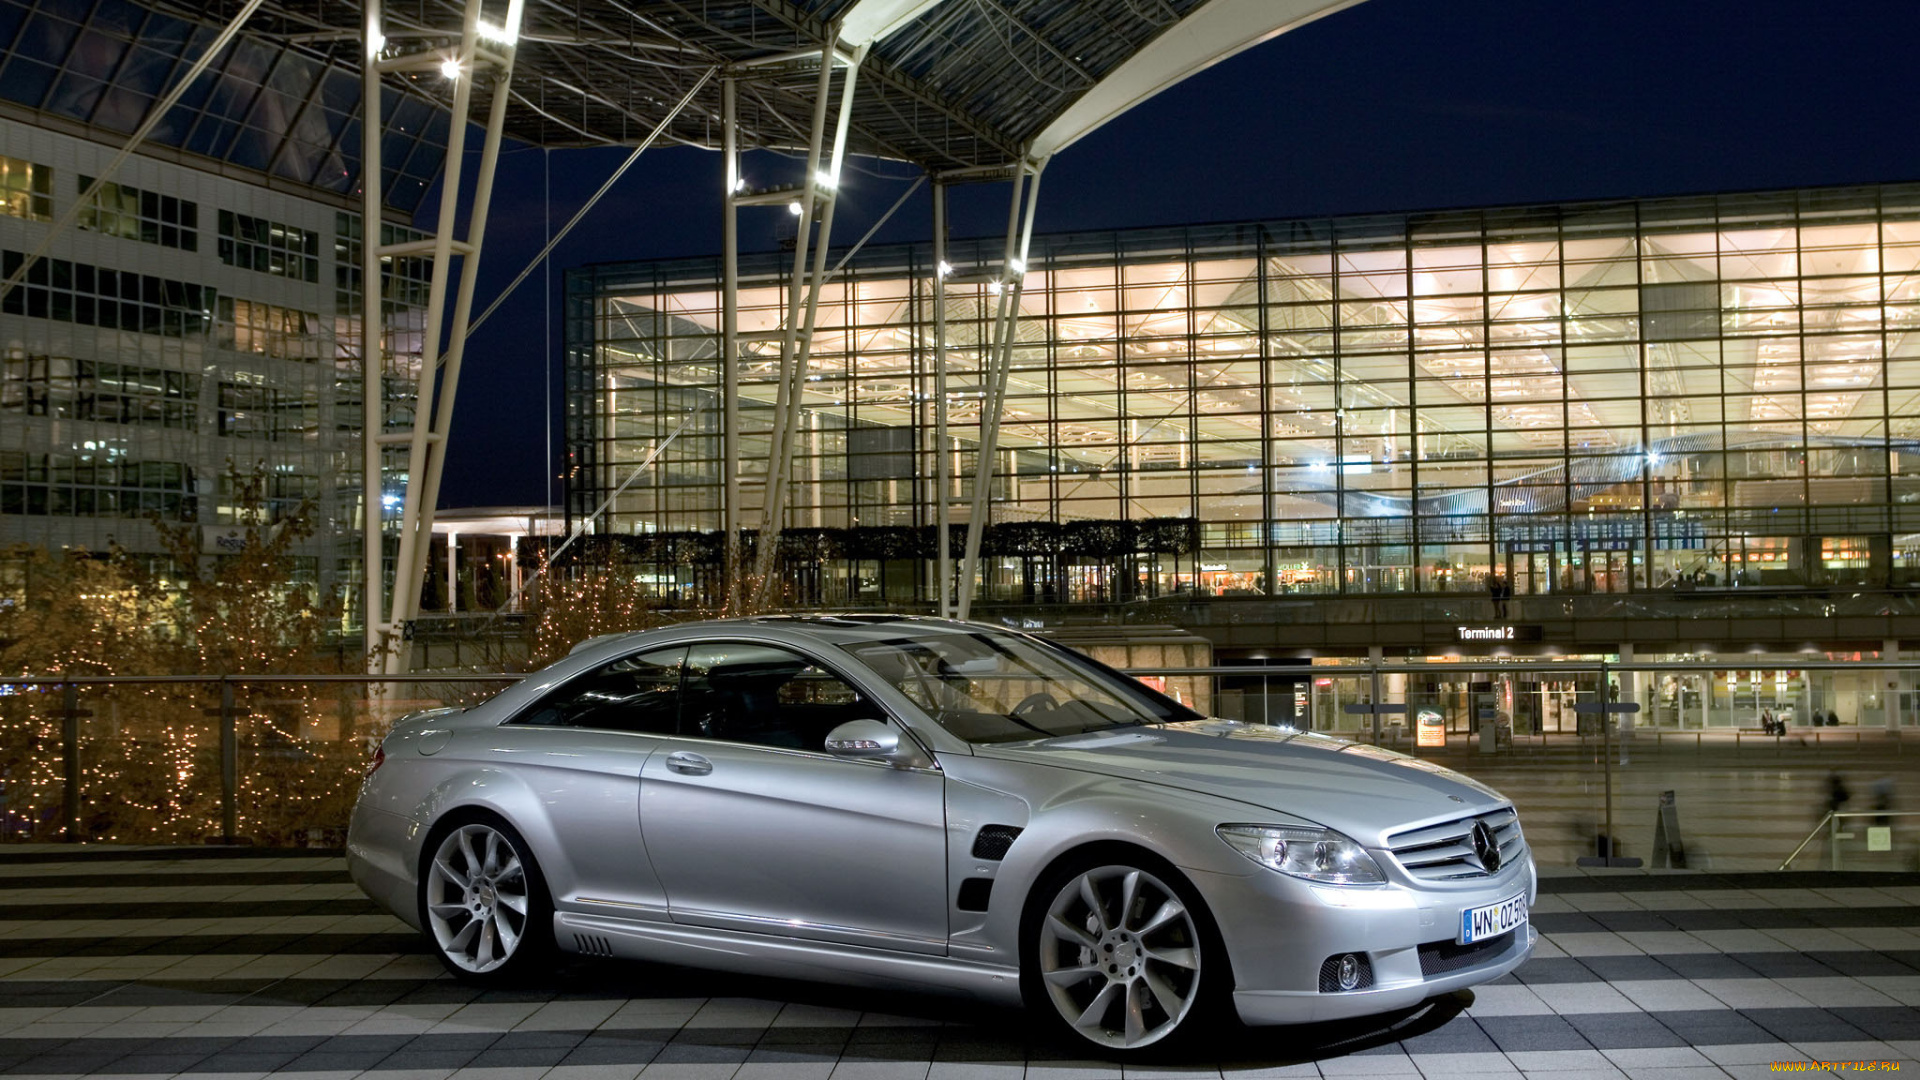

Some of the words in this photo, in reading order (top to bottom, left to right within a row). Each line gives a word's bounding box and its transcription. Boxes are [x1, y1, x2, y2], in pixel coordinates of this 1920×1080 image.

[1458, 626, 1505, 639] Terminal
[1506, 626, 1514, 639] 2
[1474, 909, 1493, 937] WN
[1501, 903, 1513, 930] OZ
